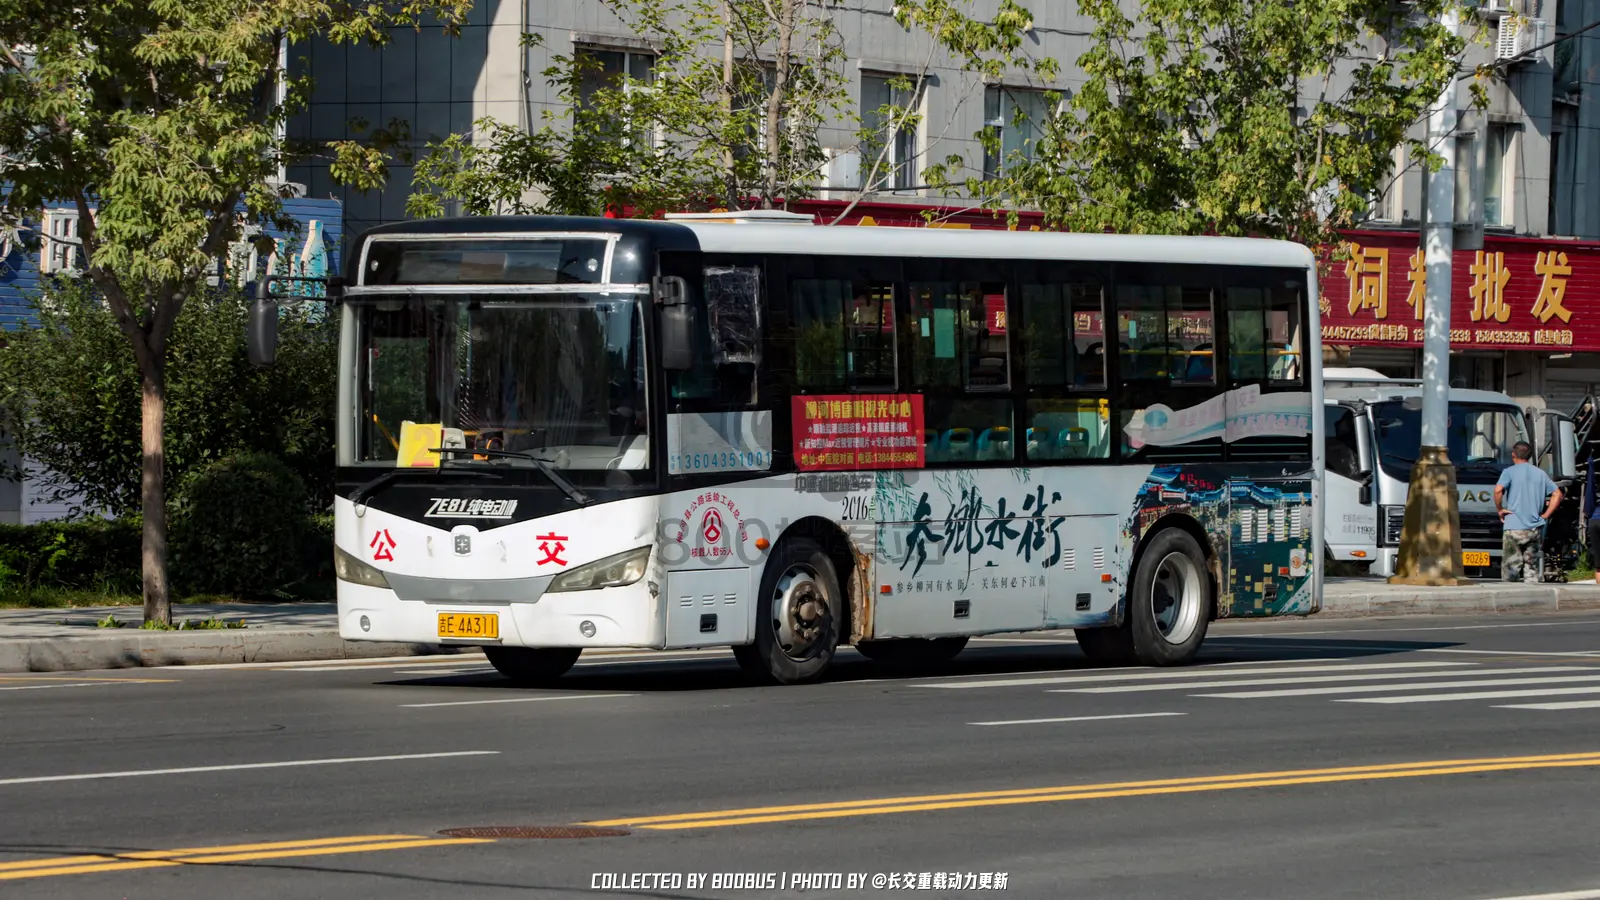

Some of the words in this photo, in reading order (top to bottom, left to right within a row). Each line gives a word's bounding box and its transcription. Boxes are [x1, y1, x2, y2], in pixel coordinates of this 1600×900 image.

[1320, 324, 1408, 341] 44457293(微信同步)
[411, 427, 436, 466] 2
[677, 451, 772, 469] 13604351001
[370, 529, 397, 562] 公
[536, 532, 569, 566] 交
